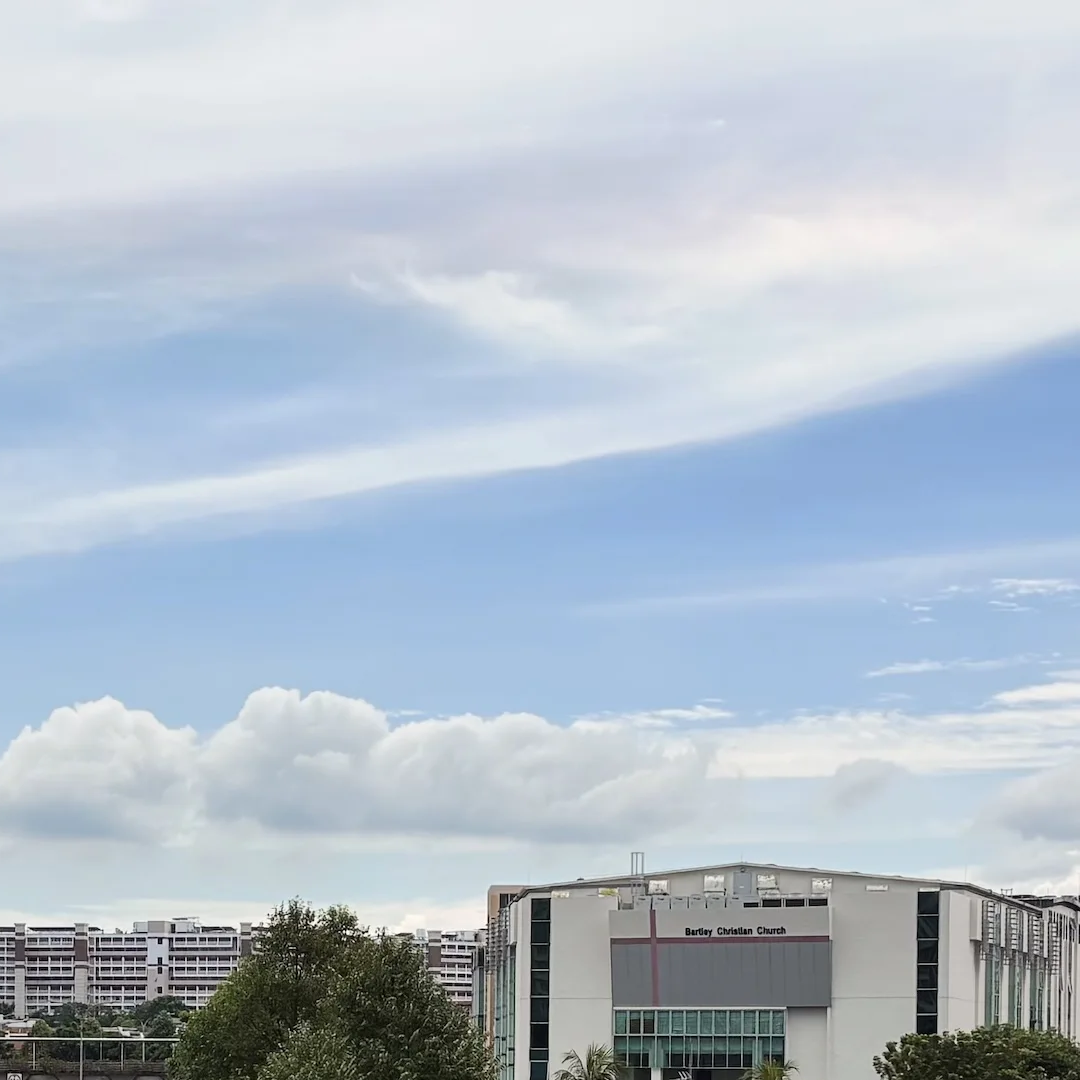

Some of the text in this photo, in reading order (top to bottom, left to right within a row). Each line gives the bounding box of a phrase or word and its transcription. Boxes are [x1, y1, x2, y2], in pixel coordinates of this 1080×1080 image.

[685, 926, 786, 937] Bartley Christian Church
